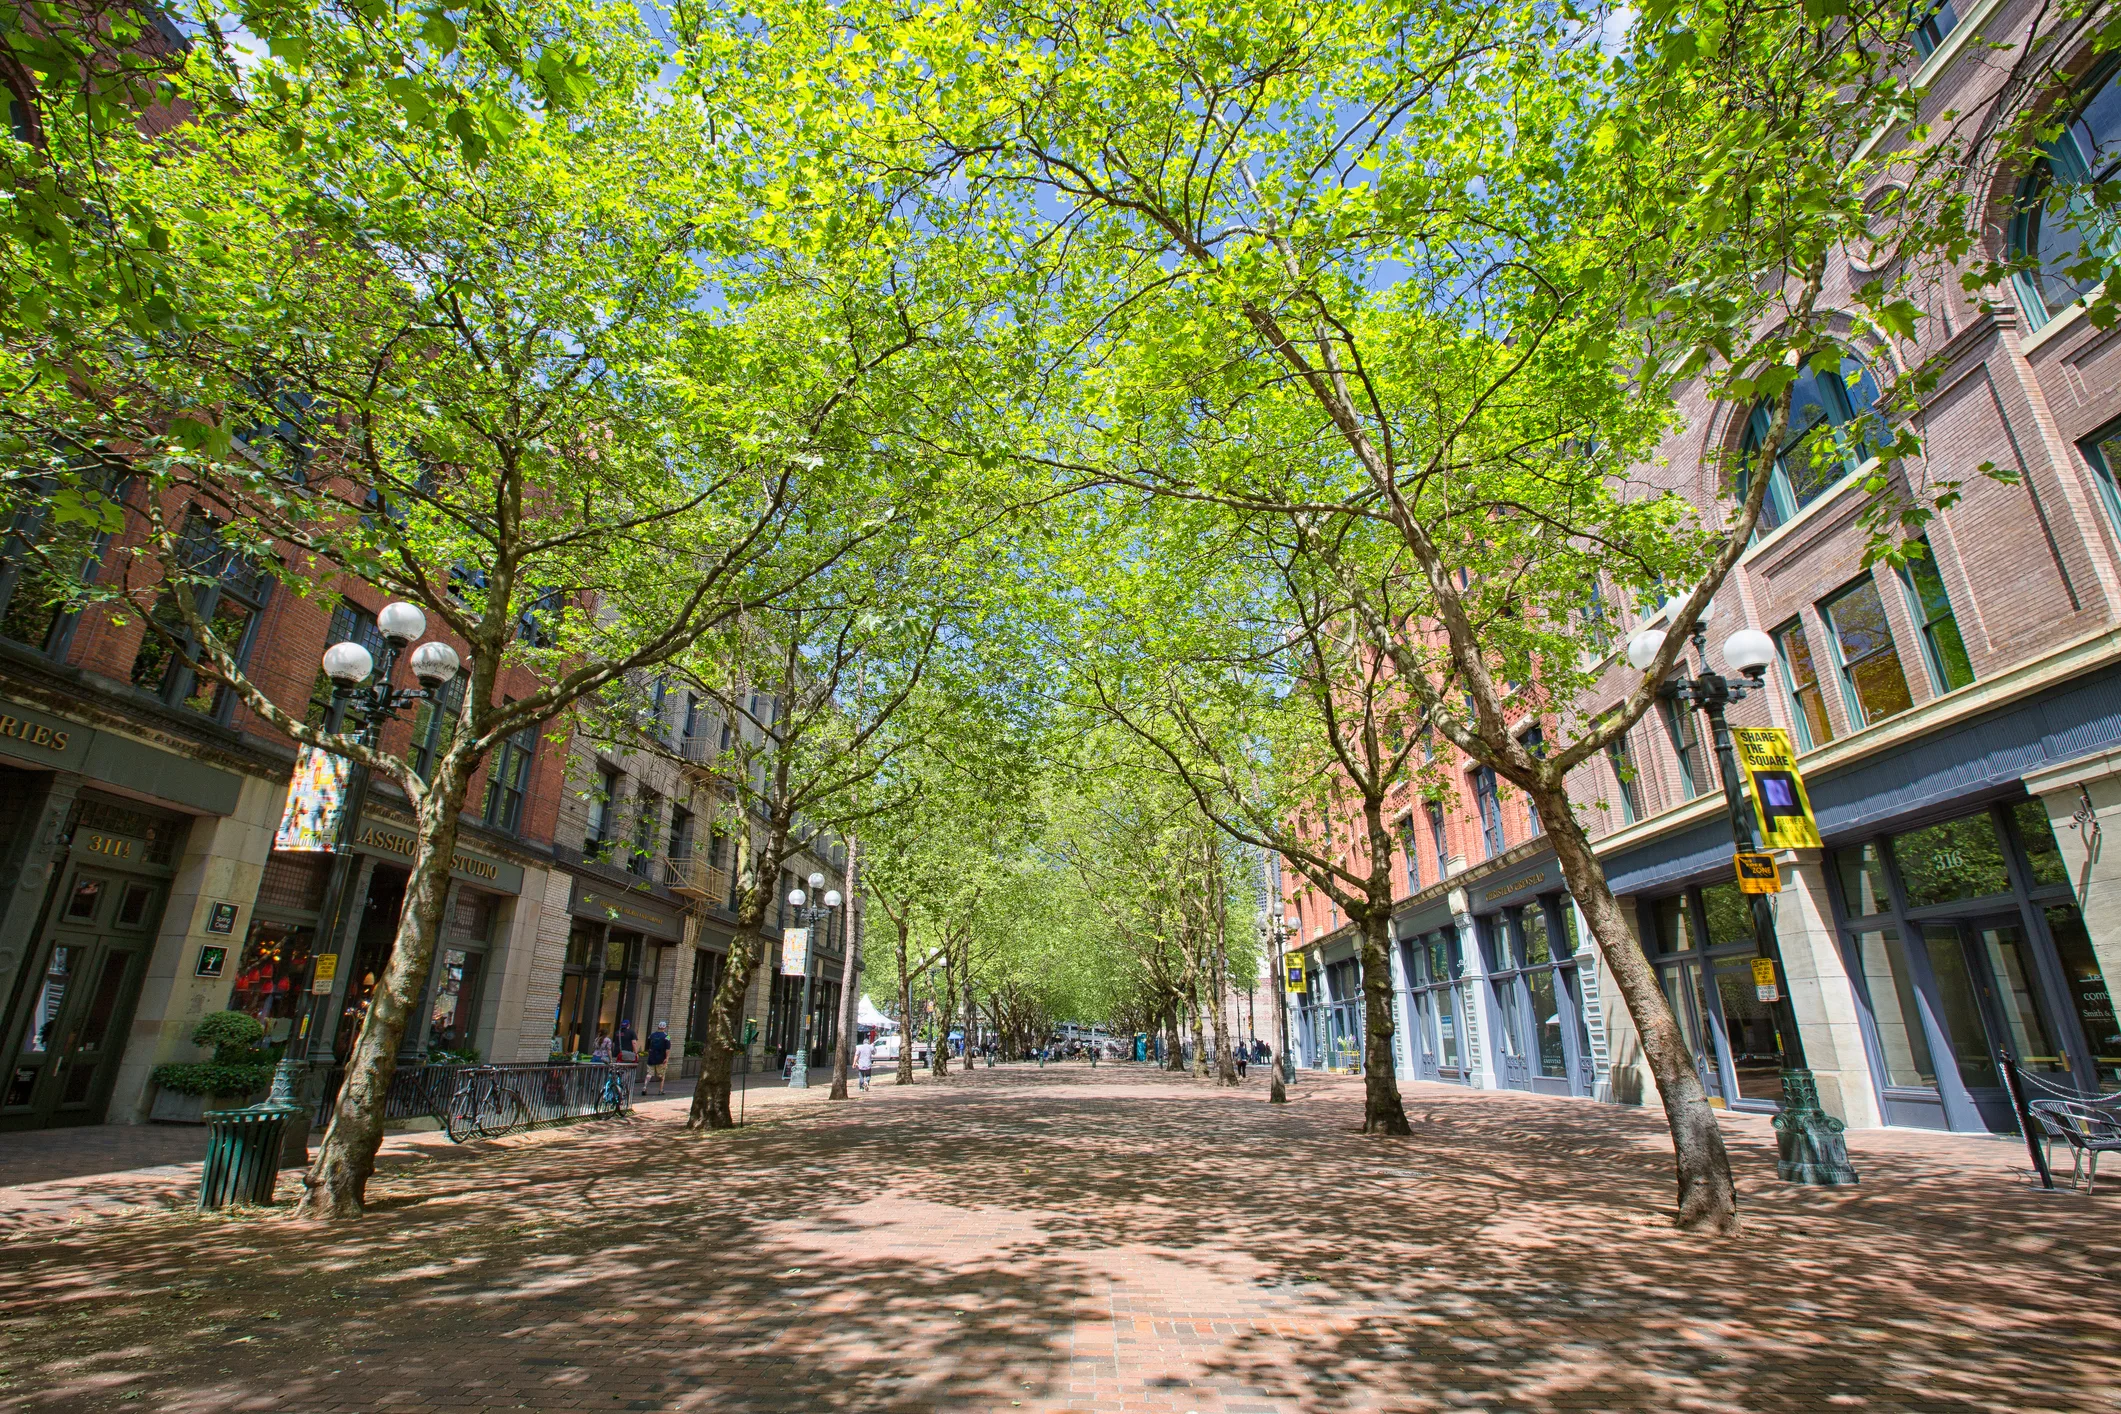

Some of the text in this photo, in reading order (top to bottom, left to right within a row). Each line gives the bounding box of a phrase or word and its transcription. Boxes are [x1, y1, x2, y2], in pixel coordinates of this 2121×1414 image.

[1740, 731, 1776, 743] SHARE
[1744, 743, 1766, 754] THE
[1748, 755, 1790, 766] SQUARE
[1933, 850, 1963, 870] 316
[450, 853, 498, 880] STUDIO
[1752, 866, 1772, 875] ZONE
